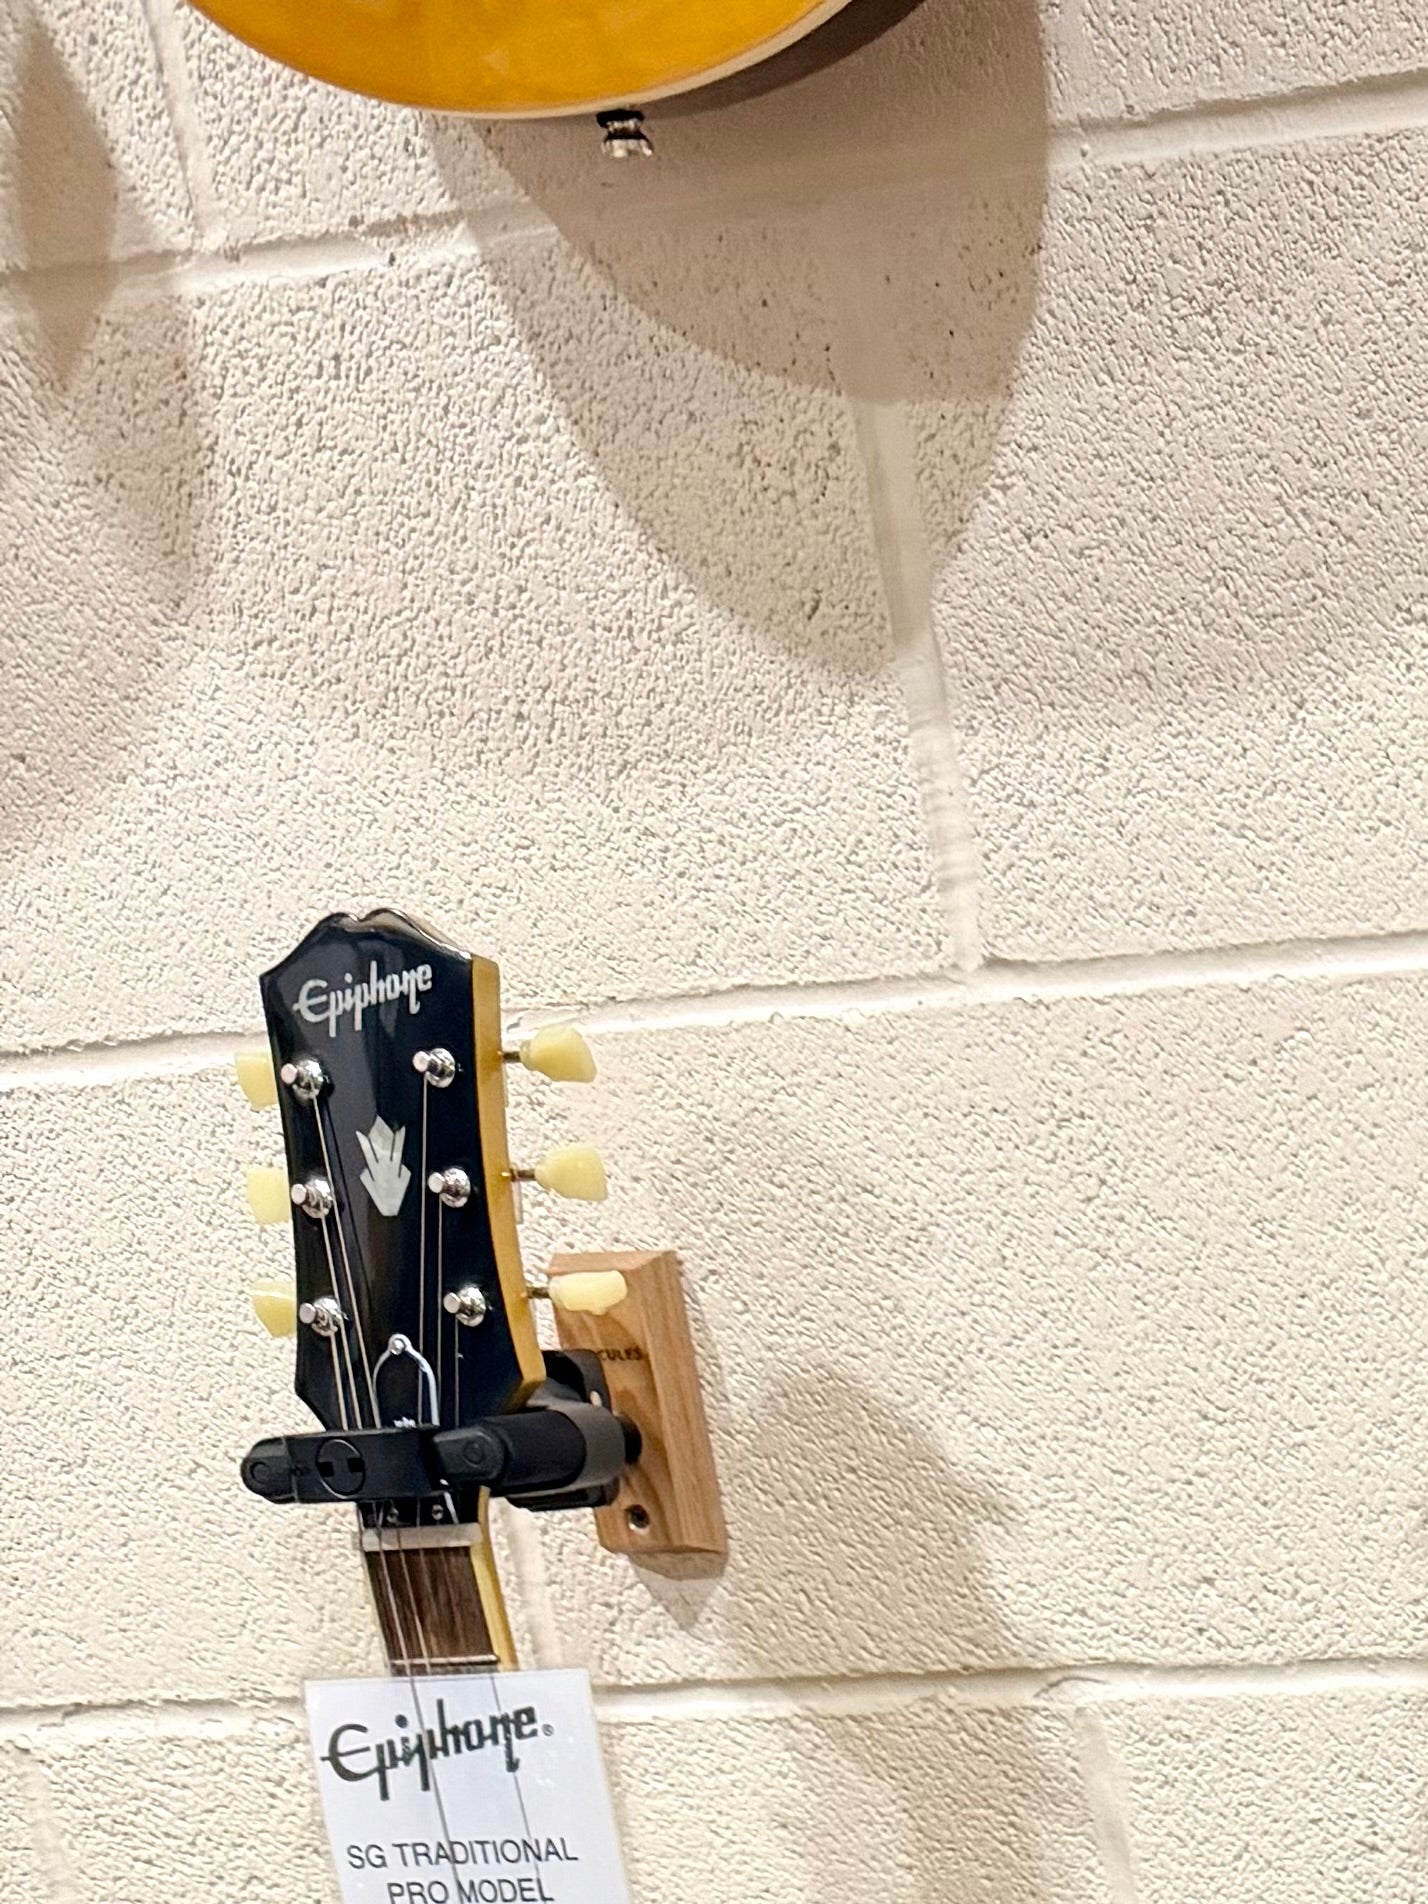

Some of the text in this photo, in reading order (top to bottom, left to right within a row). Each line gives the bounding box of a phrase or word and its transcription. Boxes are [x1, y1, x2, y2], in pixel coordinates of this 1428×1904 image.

[292, 960, 433, 1038] Epiphone
[348, 1838, 578, 1870] SG TRADITIONAL
[455, 1878, 554, 1903] MODEL
